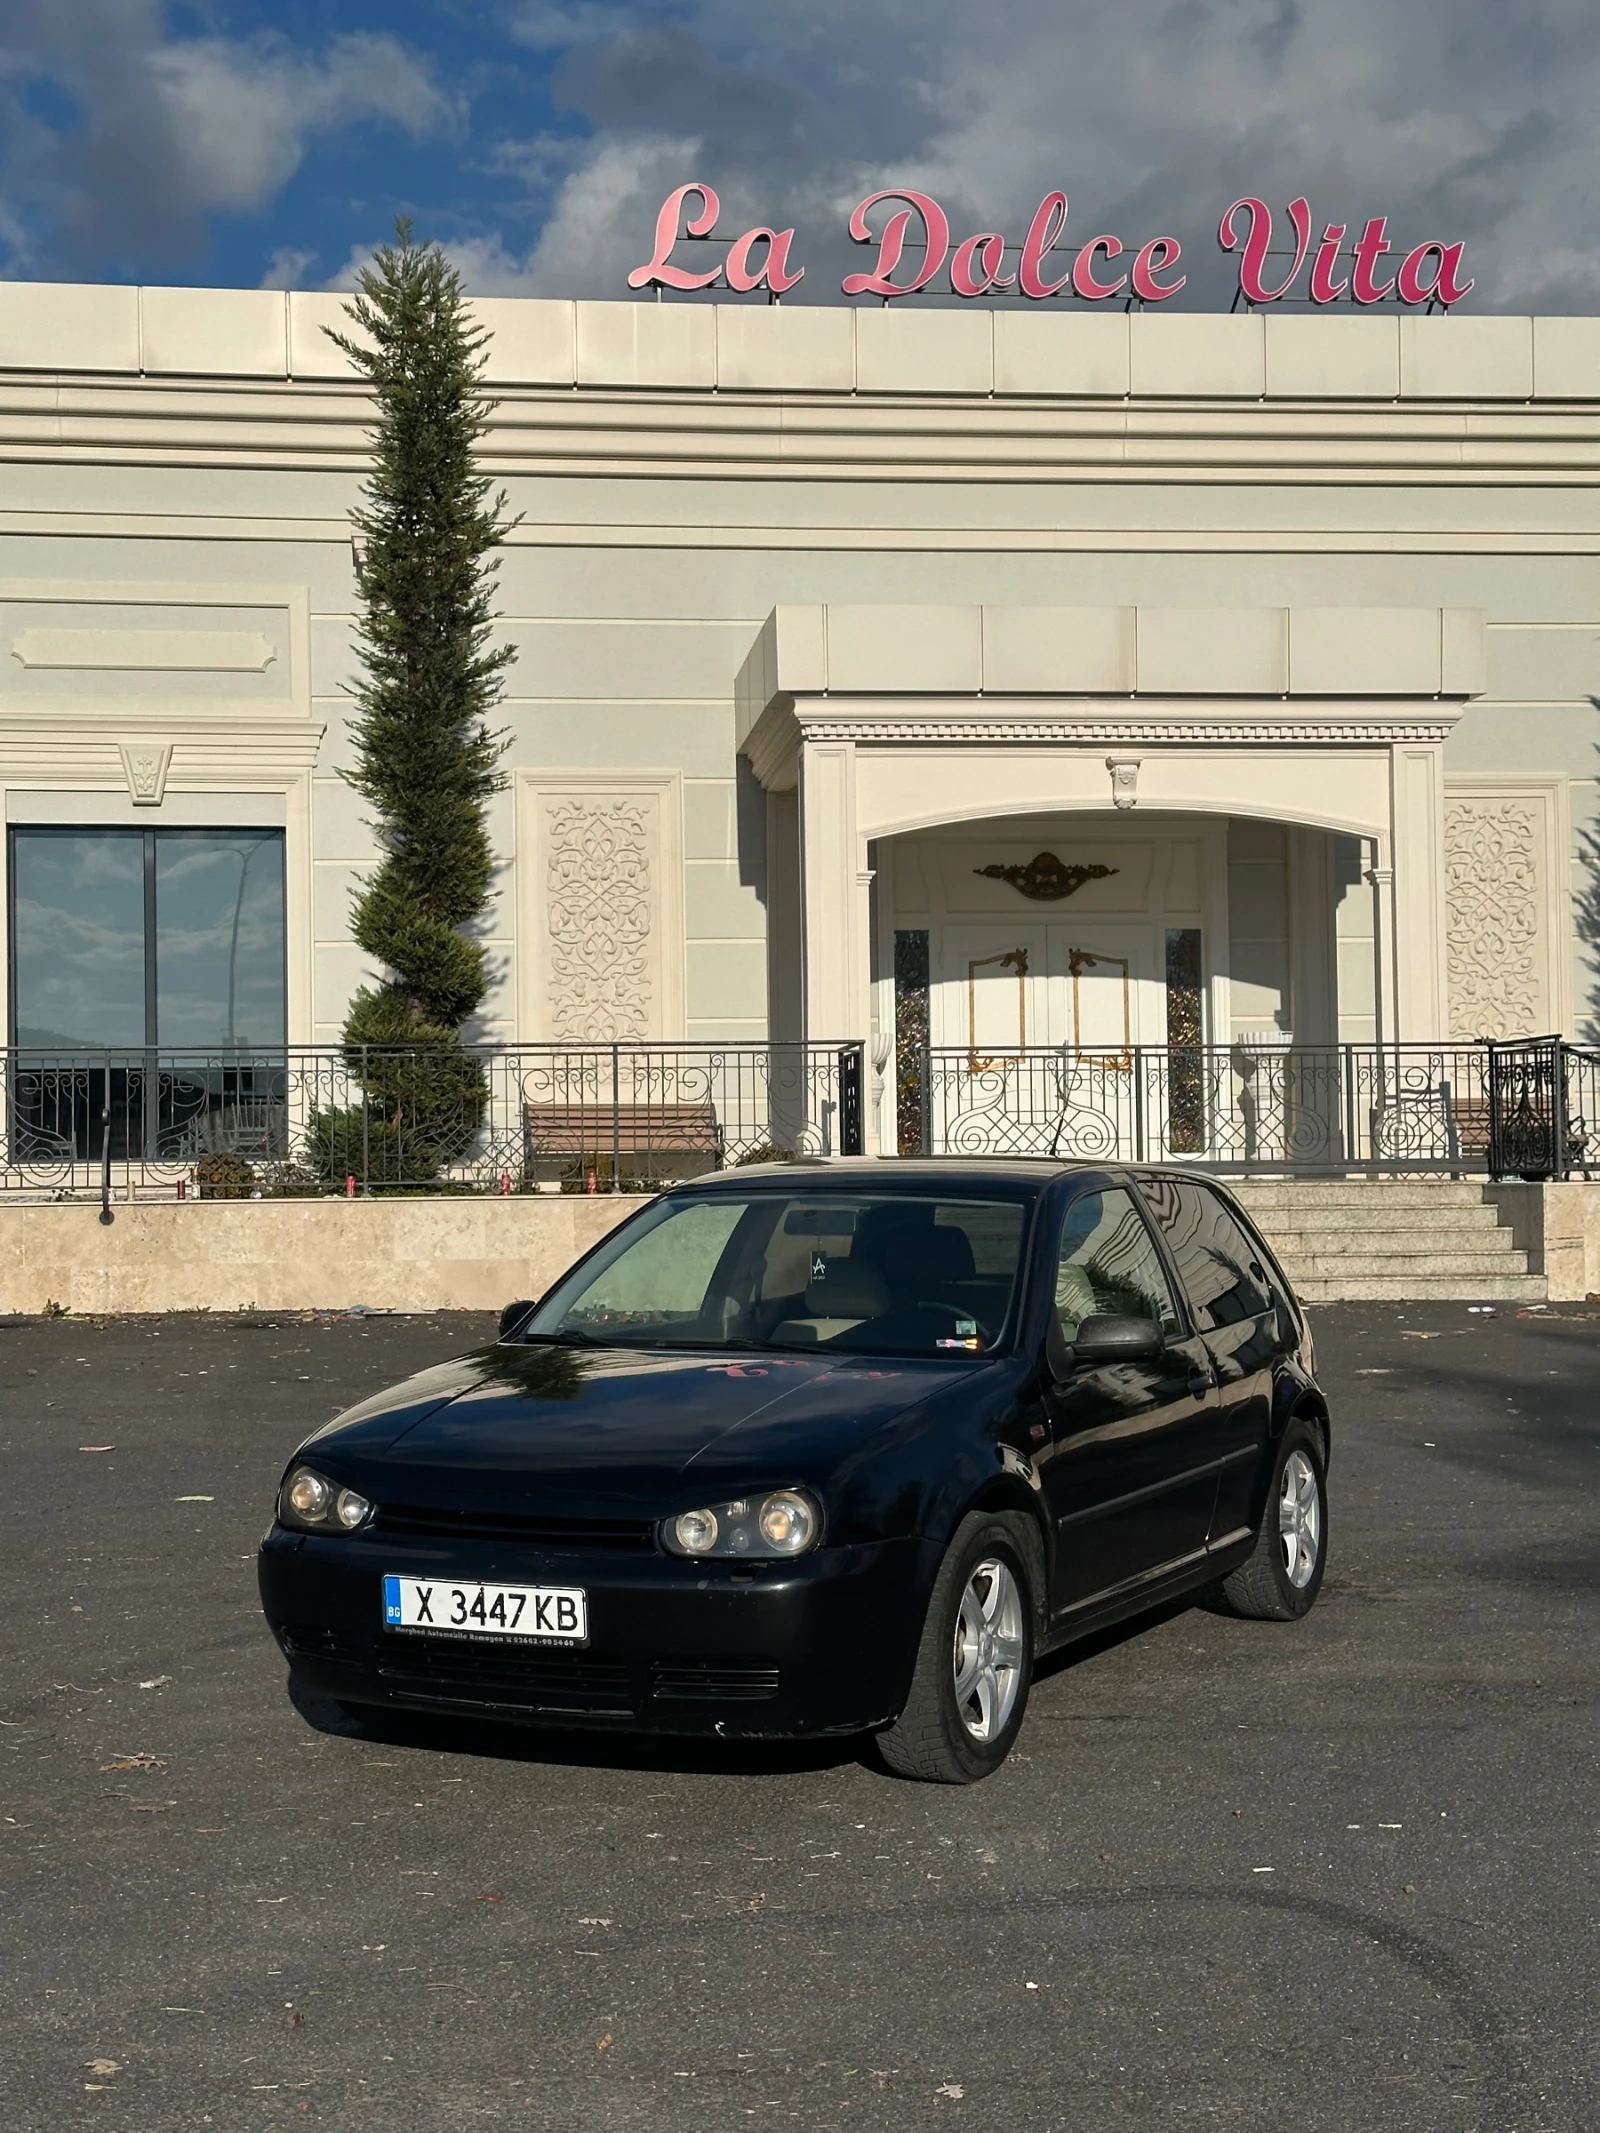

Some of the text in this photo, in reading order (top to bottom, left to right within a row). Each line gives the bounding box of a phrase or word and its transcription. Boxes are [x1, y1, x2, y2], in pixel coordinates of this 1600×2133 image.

[627, 182, 1475, 306] La Dolce Vita
[388, 1606, 401, 1618] BG
[415, 1586, 579, 1632] X 3447 KB
